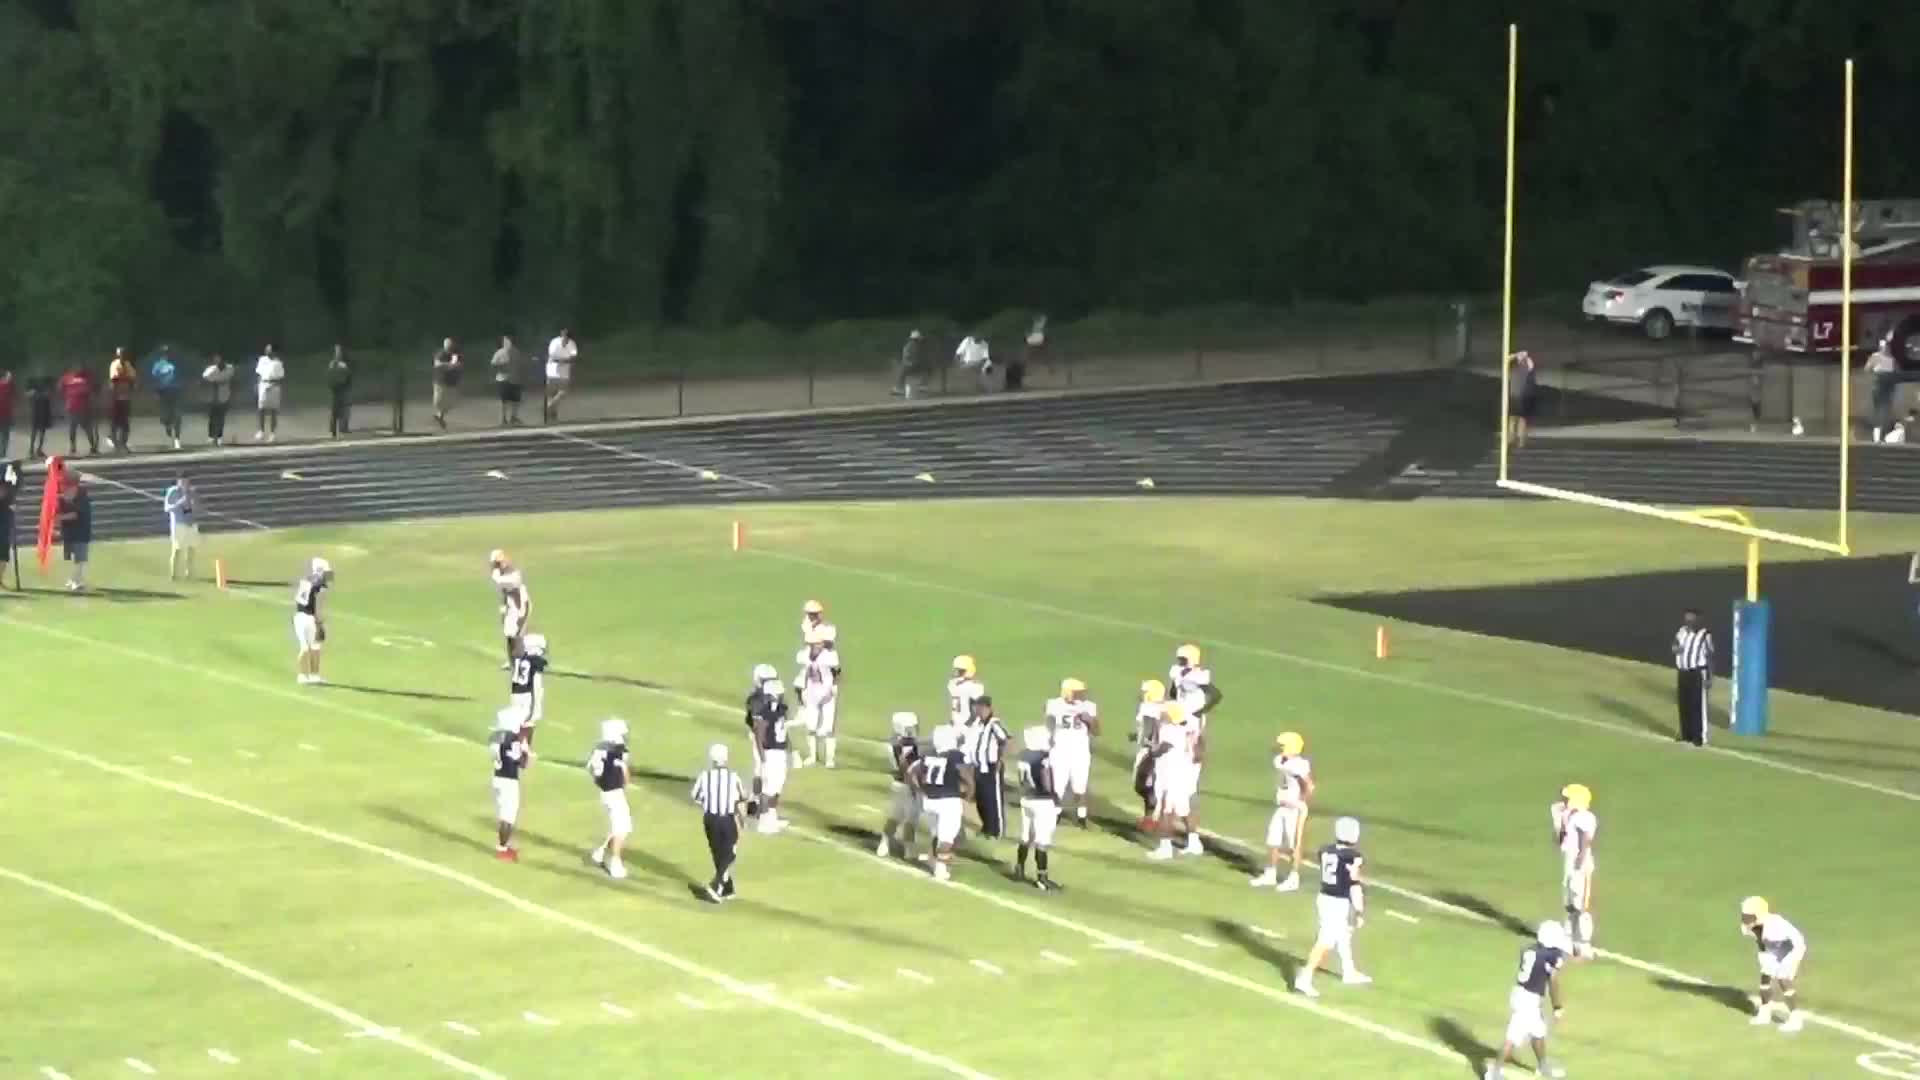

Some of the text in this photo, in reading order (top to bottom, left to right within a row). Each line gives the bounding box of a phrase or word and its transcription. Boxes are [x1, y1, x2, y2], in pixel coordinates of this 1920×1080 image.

[512, 658, 531, 686] 13
[924, 757, 948, 786] 77
[1321, 851, 1338, 884] 12
